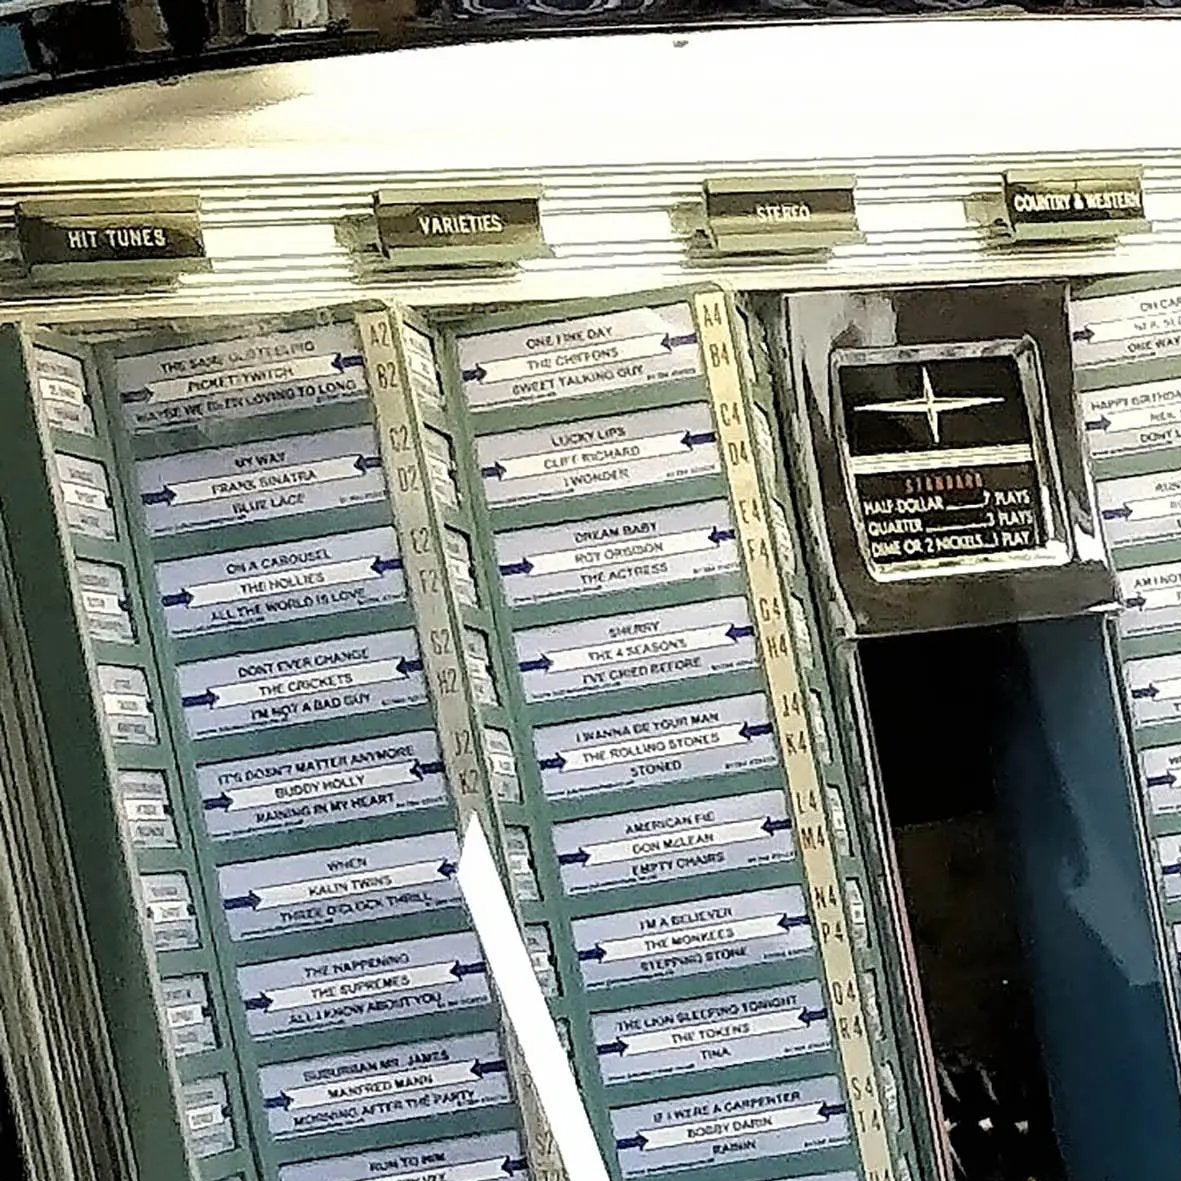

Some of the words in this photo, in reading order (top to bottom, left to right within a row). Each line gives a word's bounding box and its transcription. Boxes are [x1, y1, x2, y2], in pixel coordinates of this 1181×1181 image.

[755, 203, 811, 223] STEREO
[1014, 194, 1072, 213] COUNTRY
[1074, 193, 1084, 210] &
[1087, 190, 1143, 211] WESTERN
[418, 214, 504, 236] VARIETIES
[67, 230, 98, 250] HIT
[106, 228, 166, 249] TUNES
[702, 304, 721, 328] A4
[370, 322, 389, 347] A2
[710, 343, 729, 369] B4
[377, 362, 398, 388] B2
[720, 401, 740, 426] C4
[728, 440, 748, 466] D4
[995, 489, 1031, 506] PLAYS
[868, 519, 923, 537] QUARTER
[987, 511, 995, 527] 3
[999, 509, 1033, 527] PLAYS
[747, 537, 769, 563] F4
[872, 541, 901, 558] DIME
[903, 538, 922, 553] OR
[925, 537, 934, 552] 2
[937, 534, 983, 551] NICKELS
[1002, 529, 1030, 547] PLAY
[240, 581, 263, 594] THE
[268, 571, 324, 590] HOLLIES
[768, 633, 788, 659] H4
[259, 683, 283, 696] THE
[691, 712, 718, 724] MAN
[630, 758, 681, 777] STONED
[322, 774, 365, 790] HOLLY
[801, 825, 825, 850] M4
